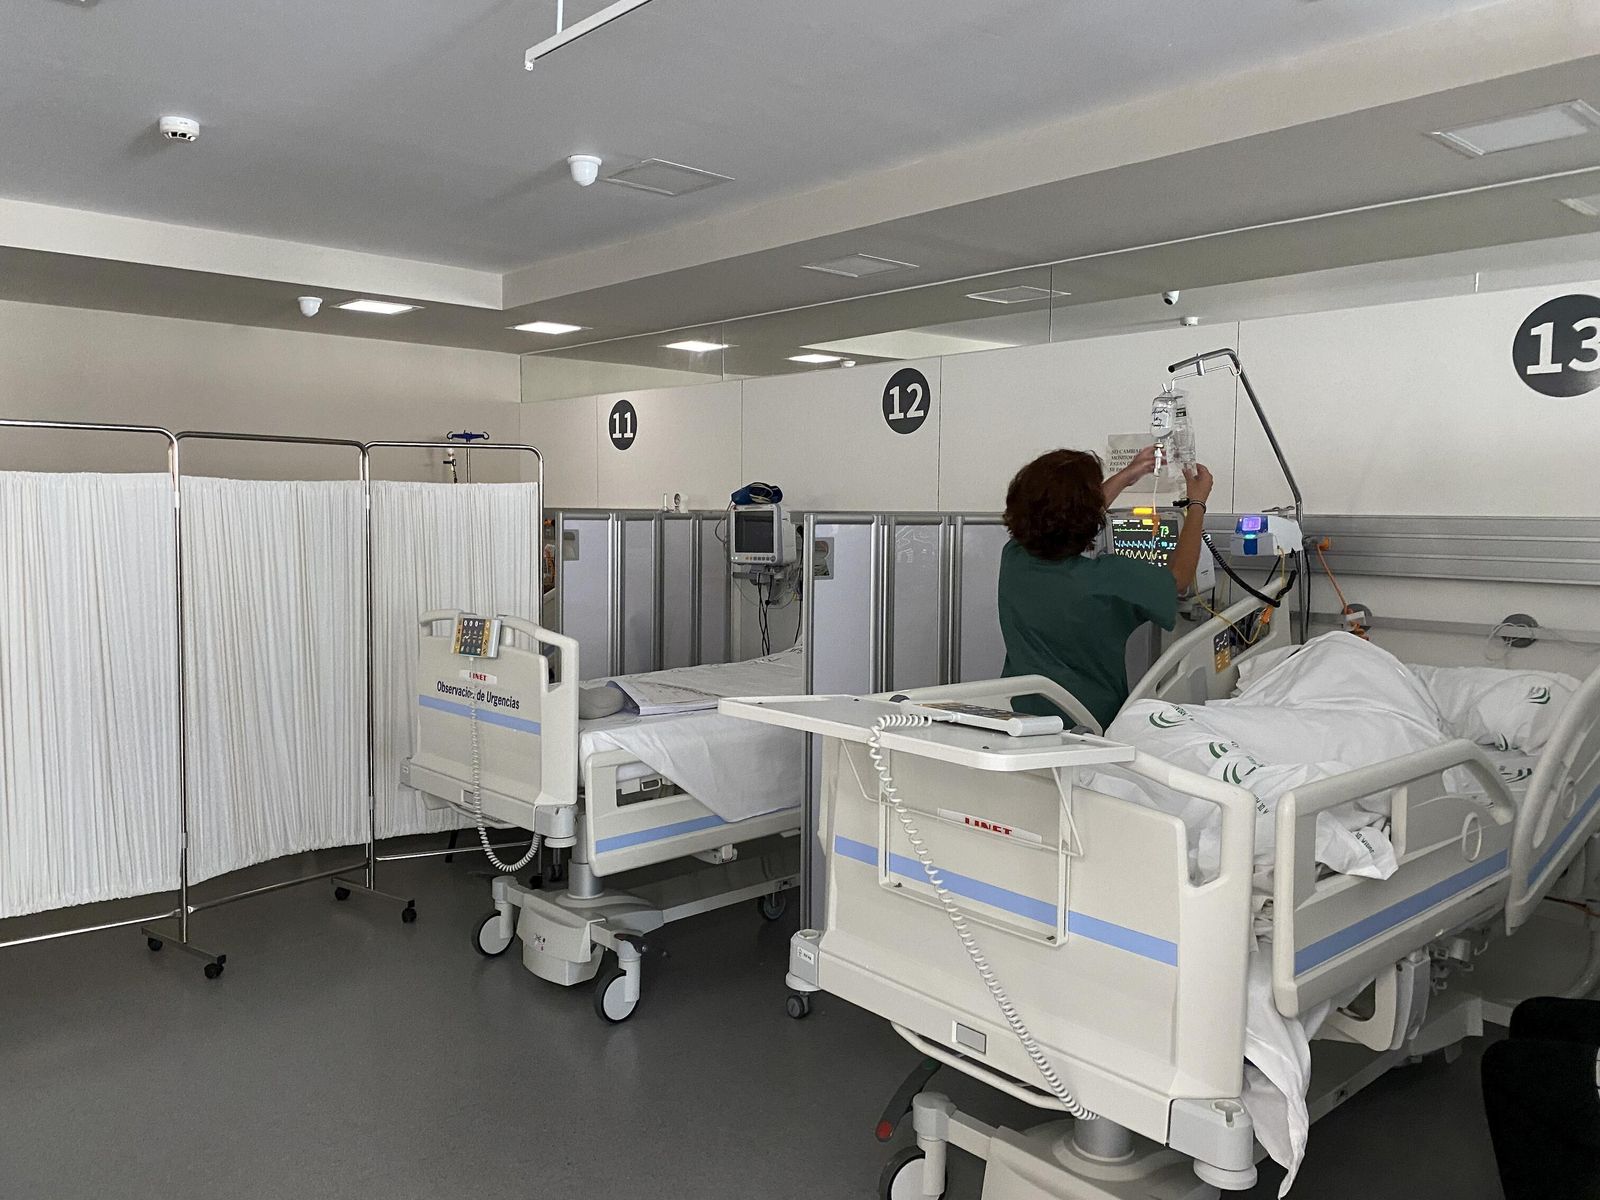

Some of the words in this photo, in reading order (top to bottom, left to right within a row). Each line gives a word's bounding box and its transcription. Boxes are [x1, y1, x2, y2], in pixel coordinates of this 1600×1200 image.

[1526, 316, 1600, 376] 13
[888, 382, 925, 421] 12
[612, 411, 634, 439] 11
[436, 680, 475, 700] Observaci
[476, 688, 485, 702] de
[486, 690, 520, 710] Urgencias
